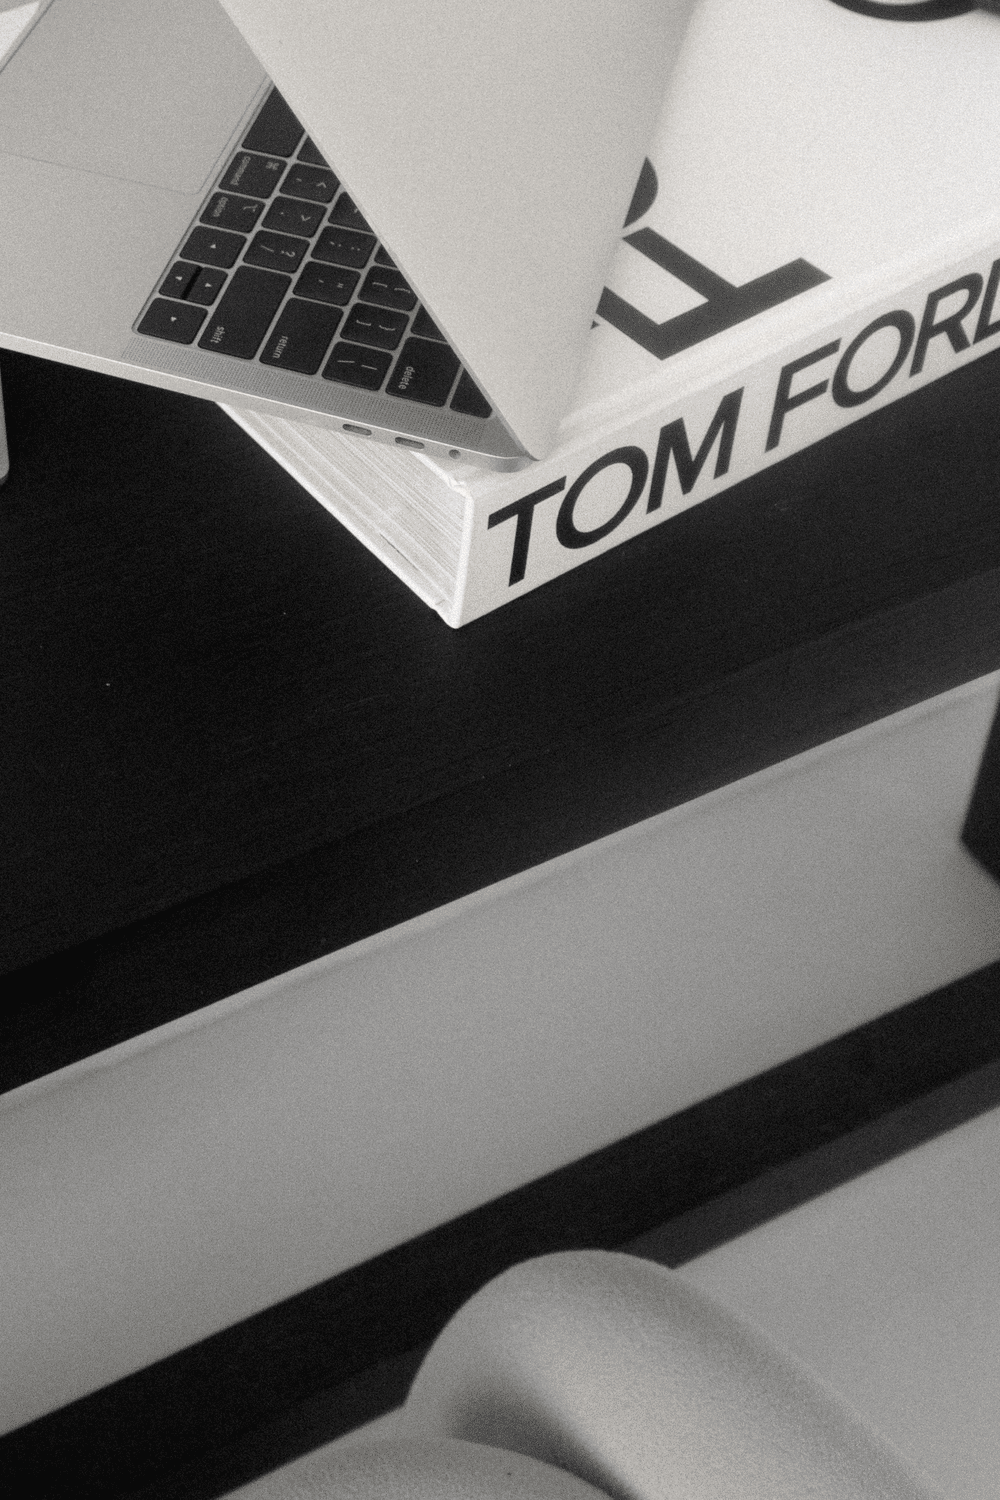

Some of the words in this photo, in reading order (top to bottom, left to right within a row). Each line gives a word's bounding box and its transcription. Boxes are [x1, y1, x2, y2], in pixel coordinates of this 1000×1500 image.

[210, 326, 225, 344] shift
[272, 336, 289, 359] return
[398, 366, 415, 389] delete
[487, 385, 745, 587] TOM
